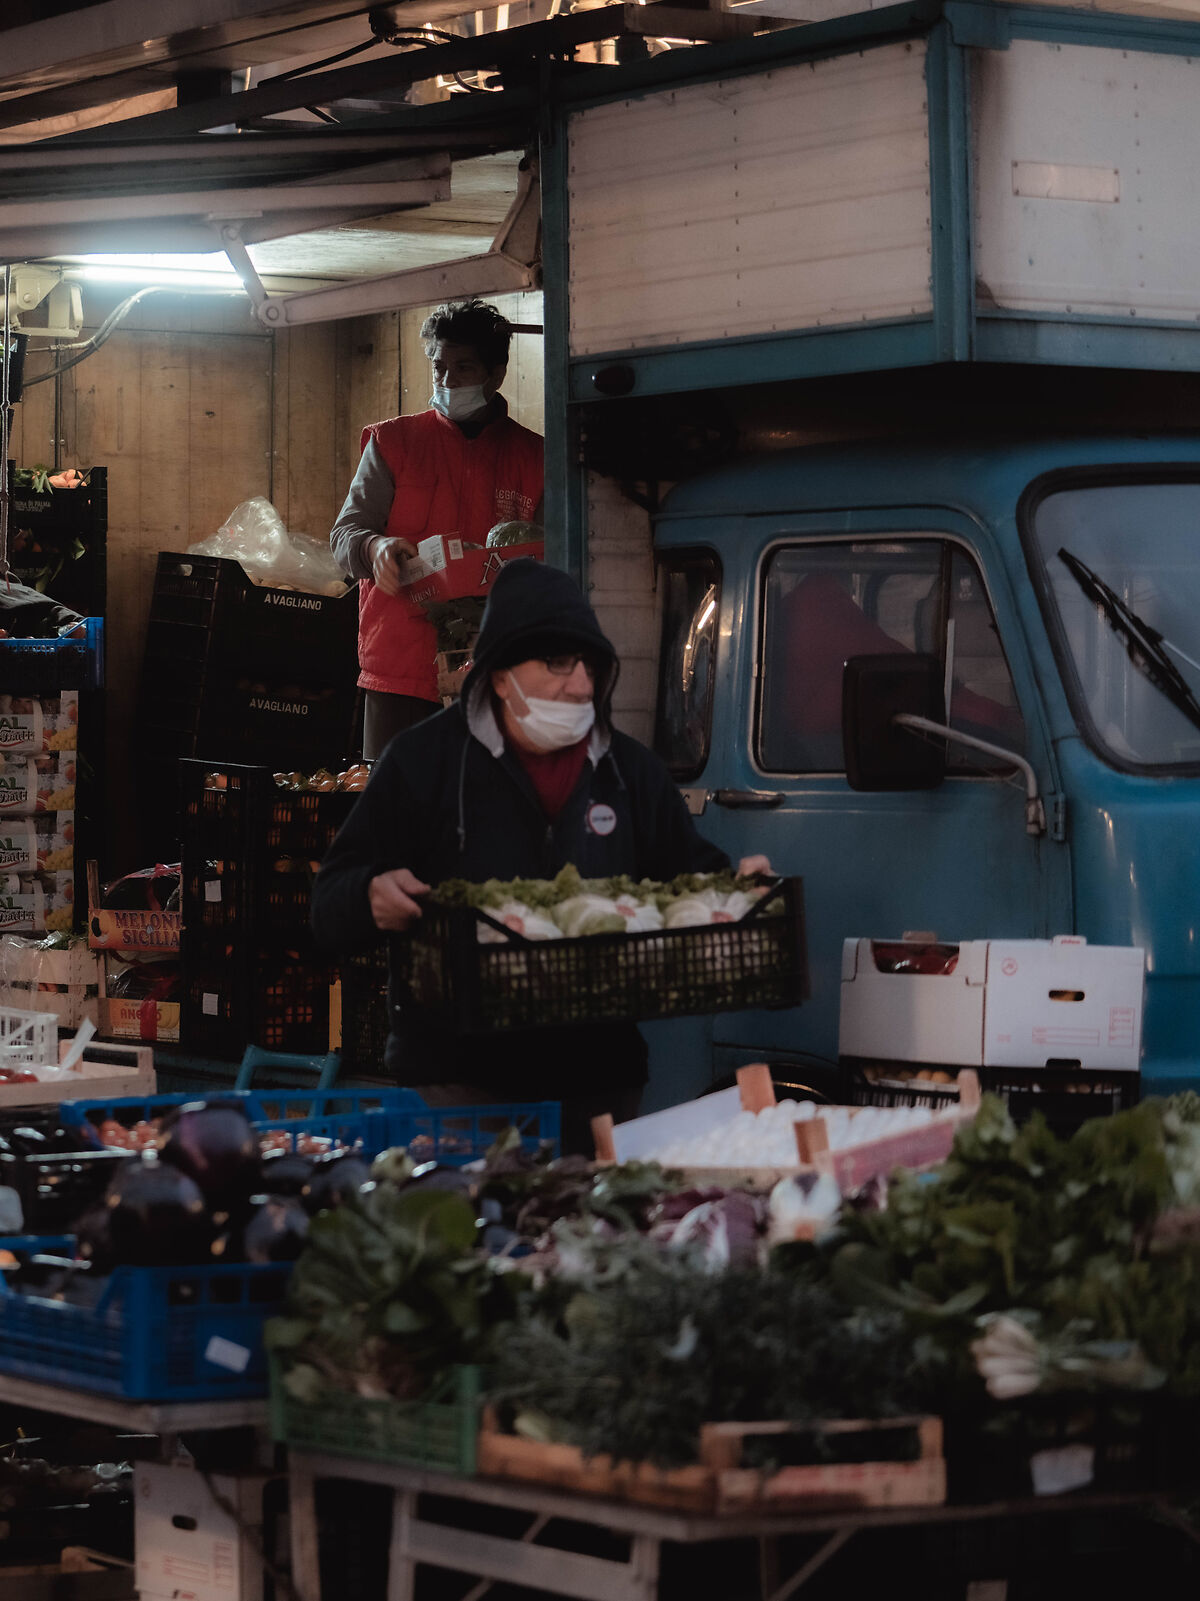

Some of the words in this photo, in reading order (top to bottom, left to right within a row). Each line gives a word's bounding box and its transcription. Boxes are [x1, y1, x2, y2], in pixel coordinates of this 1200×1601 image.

[264, 593, 322, 611] AVAGLIANO
[249, 698, 309, 715] AVAGLIANO
[123, 930, 180, 946] SICILIA
